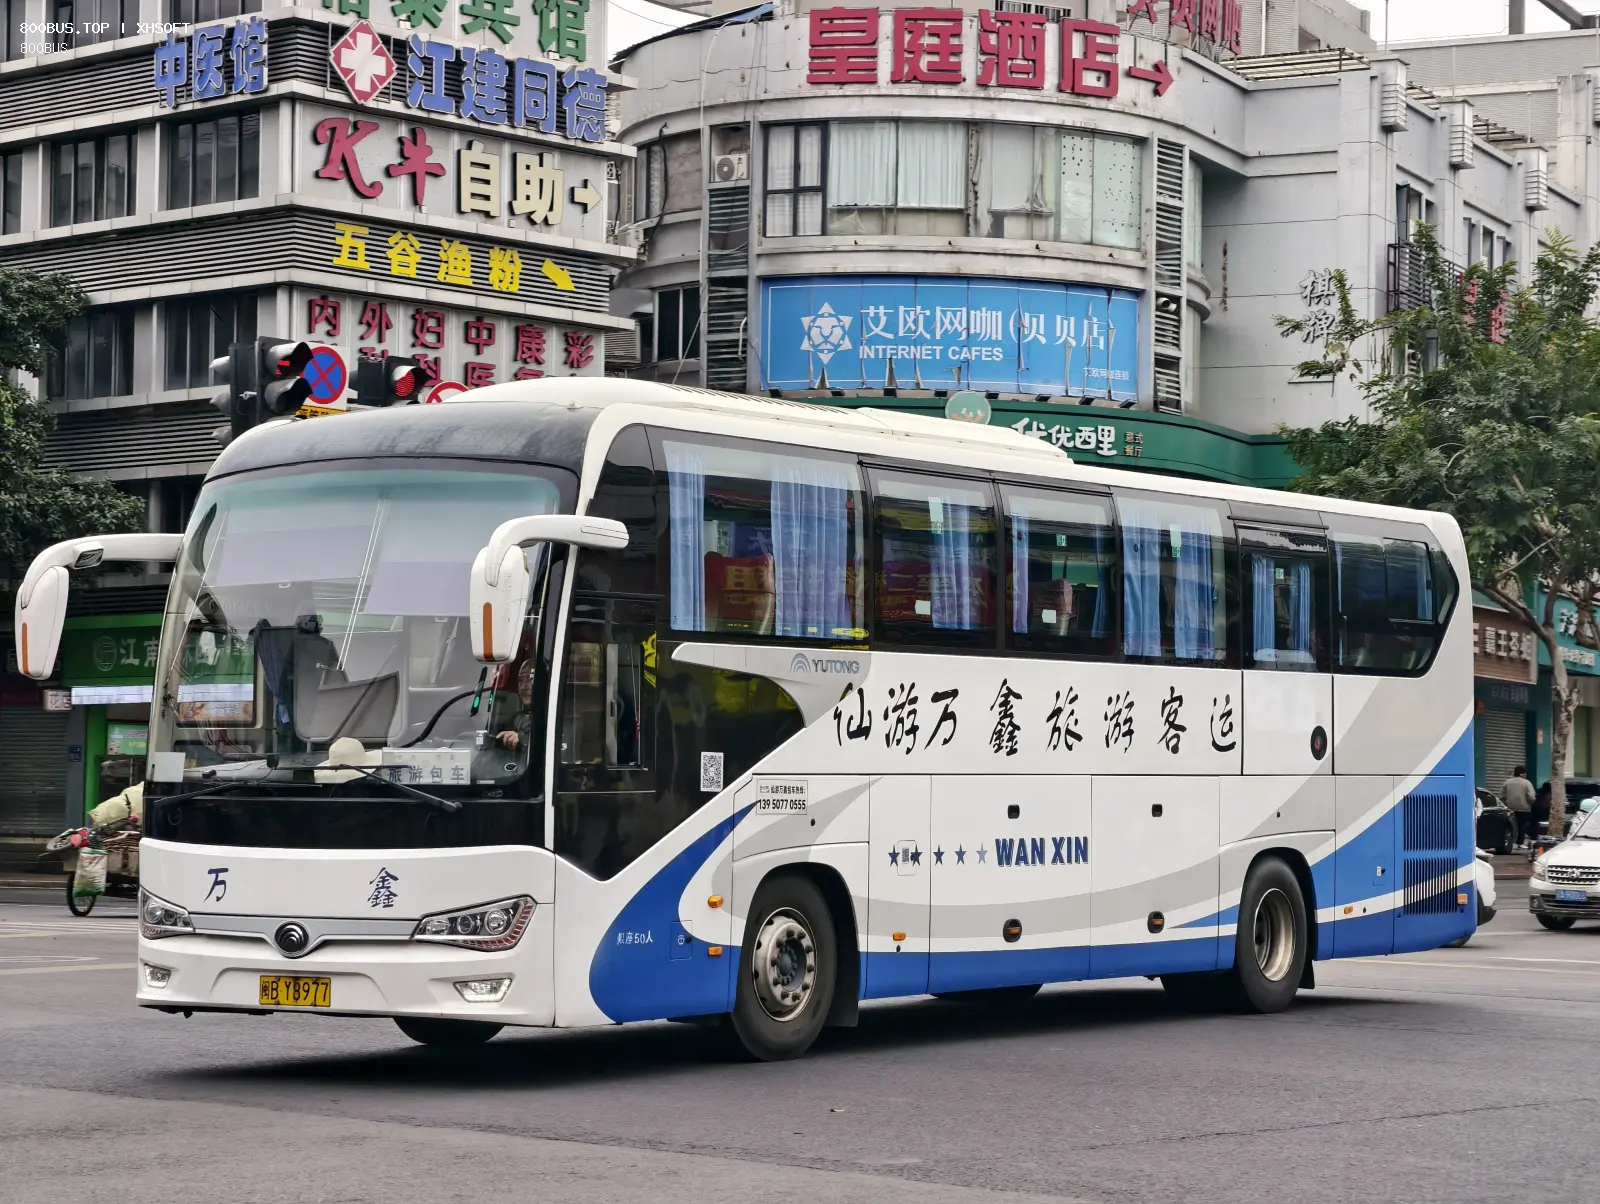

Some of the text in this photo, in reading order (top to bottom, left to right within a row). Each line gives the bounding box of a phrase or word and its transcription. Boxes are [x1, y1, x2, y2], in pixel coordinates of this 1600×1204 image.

[154, 16, 269, 108] 中医馆
[806, 7, 1120, 98] 皇庭酒店
[406, 33, 608, 143] 江建同德
[332, 222, 523, 293] 五谷渔粉
[859, 345, 1004, 362] INTERNET CAFES
[811, 659, 860, 675] YUTONG
[834, 676, 1239, 758] 仙游万鑫旅游客运
[771, 799, 788, 810] 5077
[789, 799, 806, 810] 0555
[994, 836, 1090, 868] WAN XIN
[203, 866, 400, 909] 万 鑫
